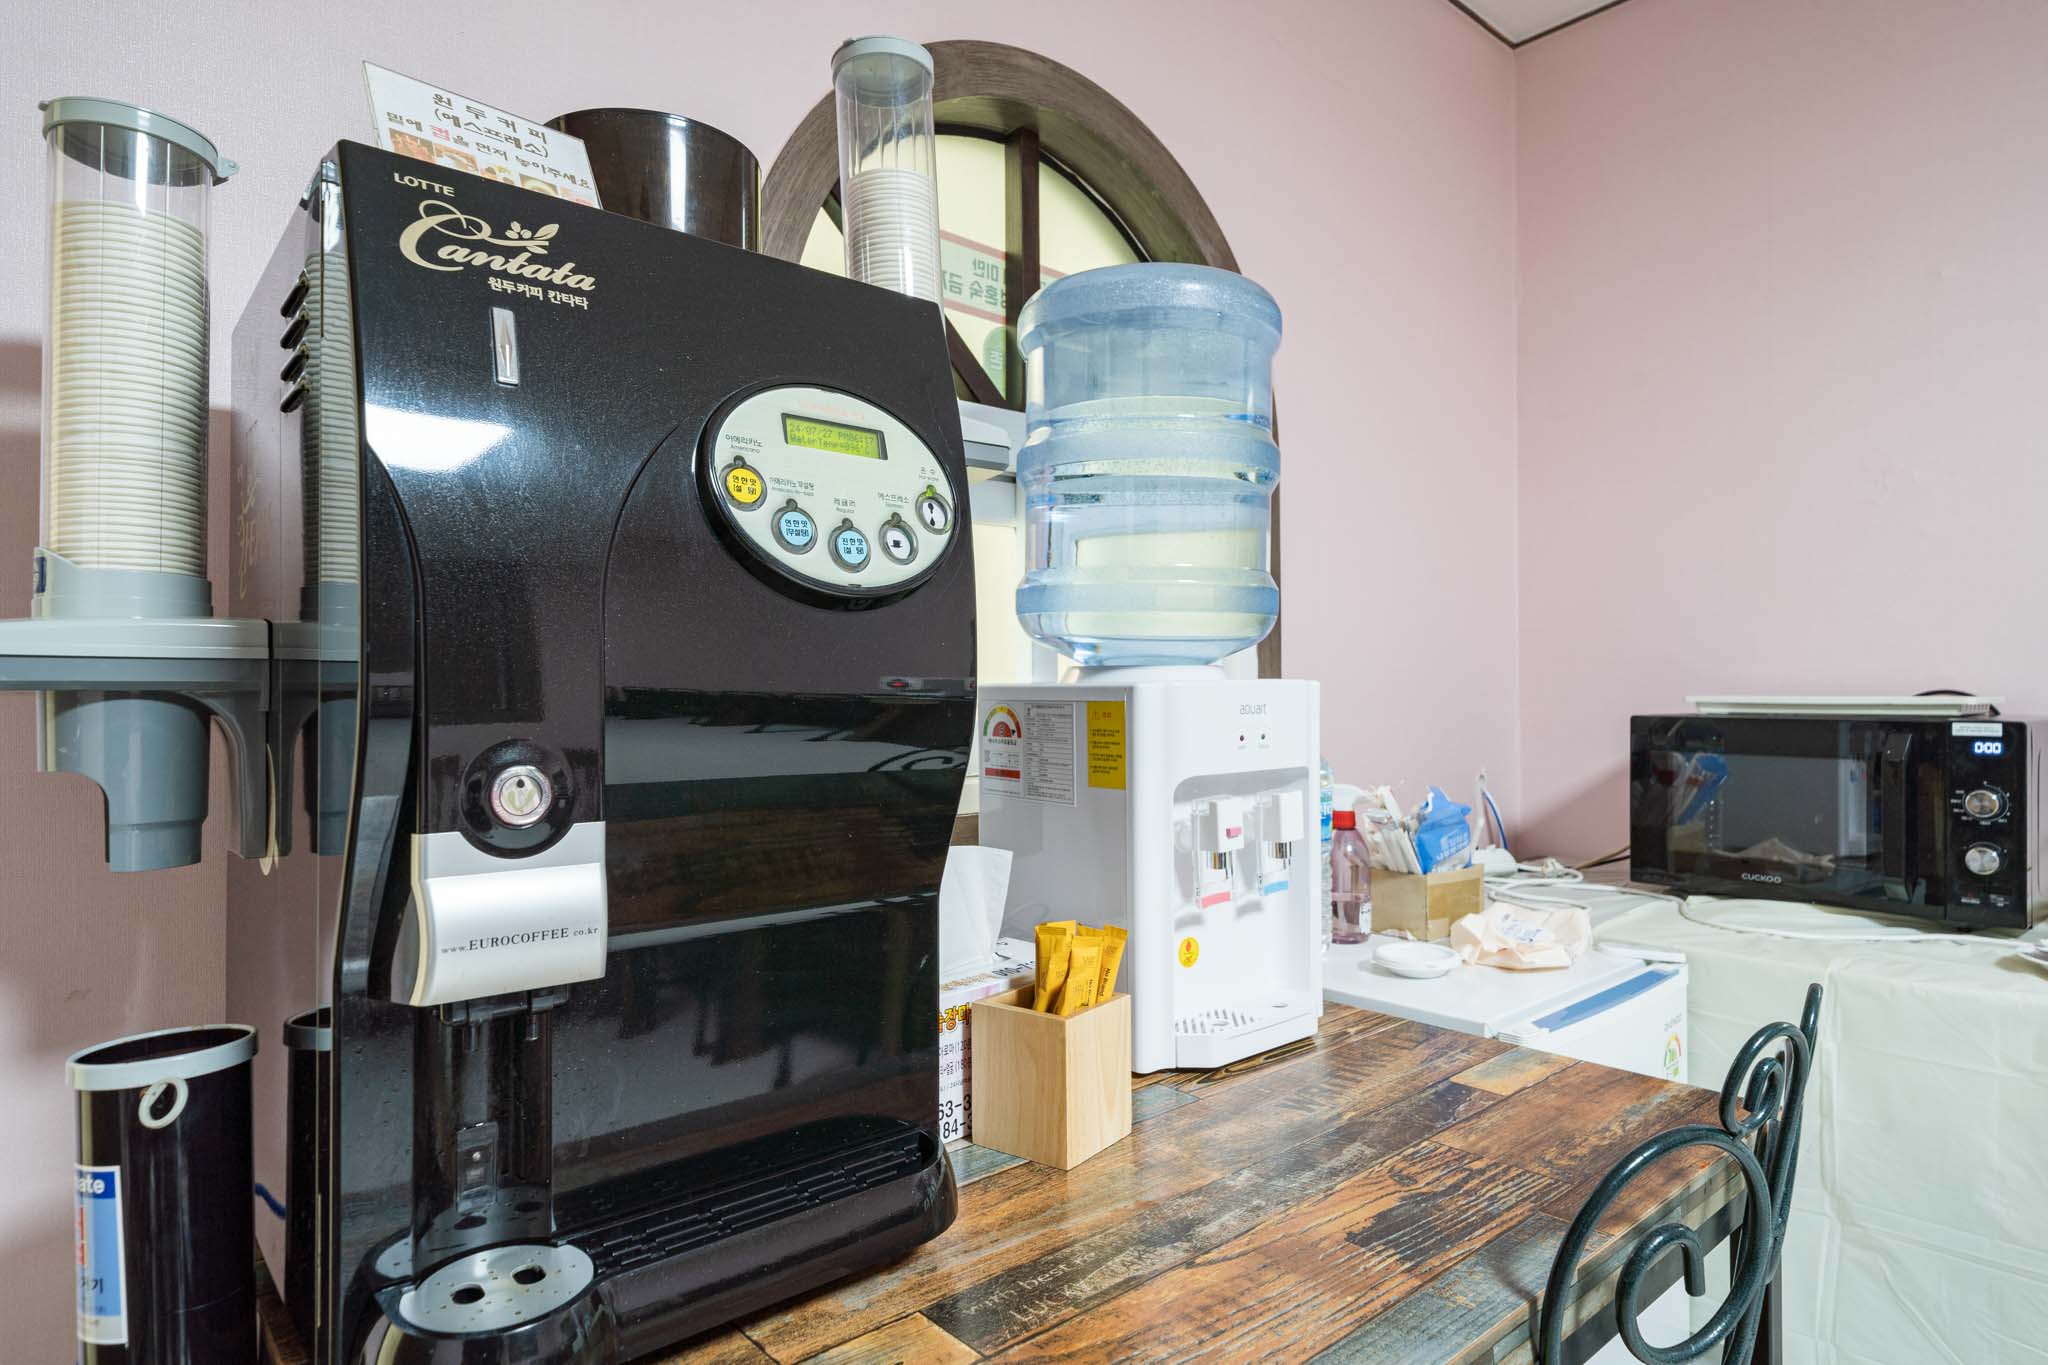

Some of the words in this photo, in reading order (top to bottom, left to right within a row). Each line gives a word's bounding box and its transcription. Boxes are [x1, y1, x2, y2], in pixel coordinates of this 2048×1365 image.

[393, 172, 456, 197] LOTTE
[399, 200, 596, 291] Cantata
[487, 276, 544, 301] 원두커피
[546, 289, 589, 311] 칸타타
